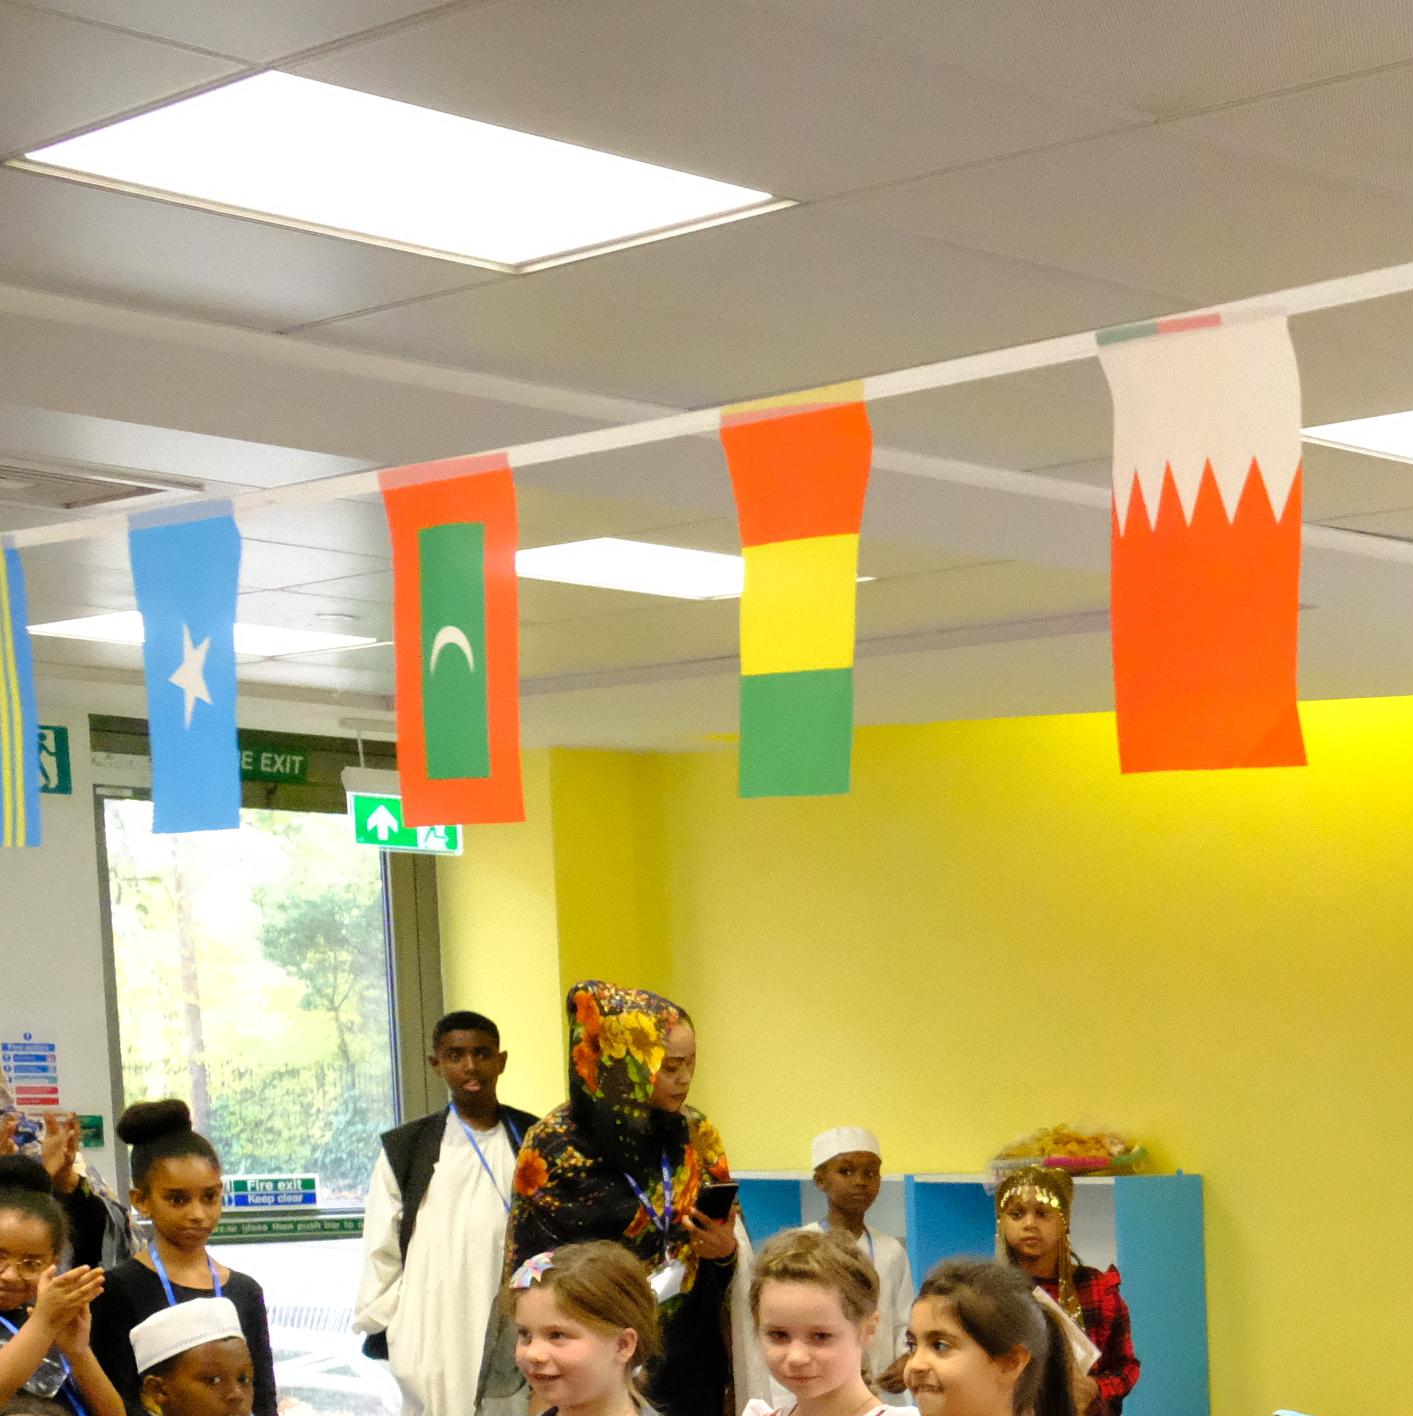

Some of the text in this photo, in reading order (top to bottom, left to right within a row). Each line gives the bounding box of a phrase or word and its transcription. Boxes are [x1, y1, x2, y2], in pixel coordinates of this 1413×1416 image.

[260, 752, 304, 775] EXIT
[247, 1179, 303, 1192] Fire exit
[247, 1192, 304, 1205] Keep clear
